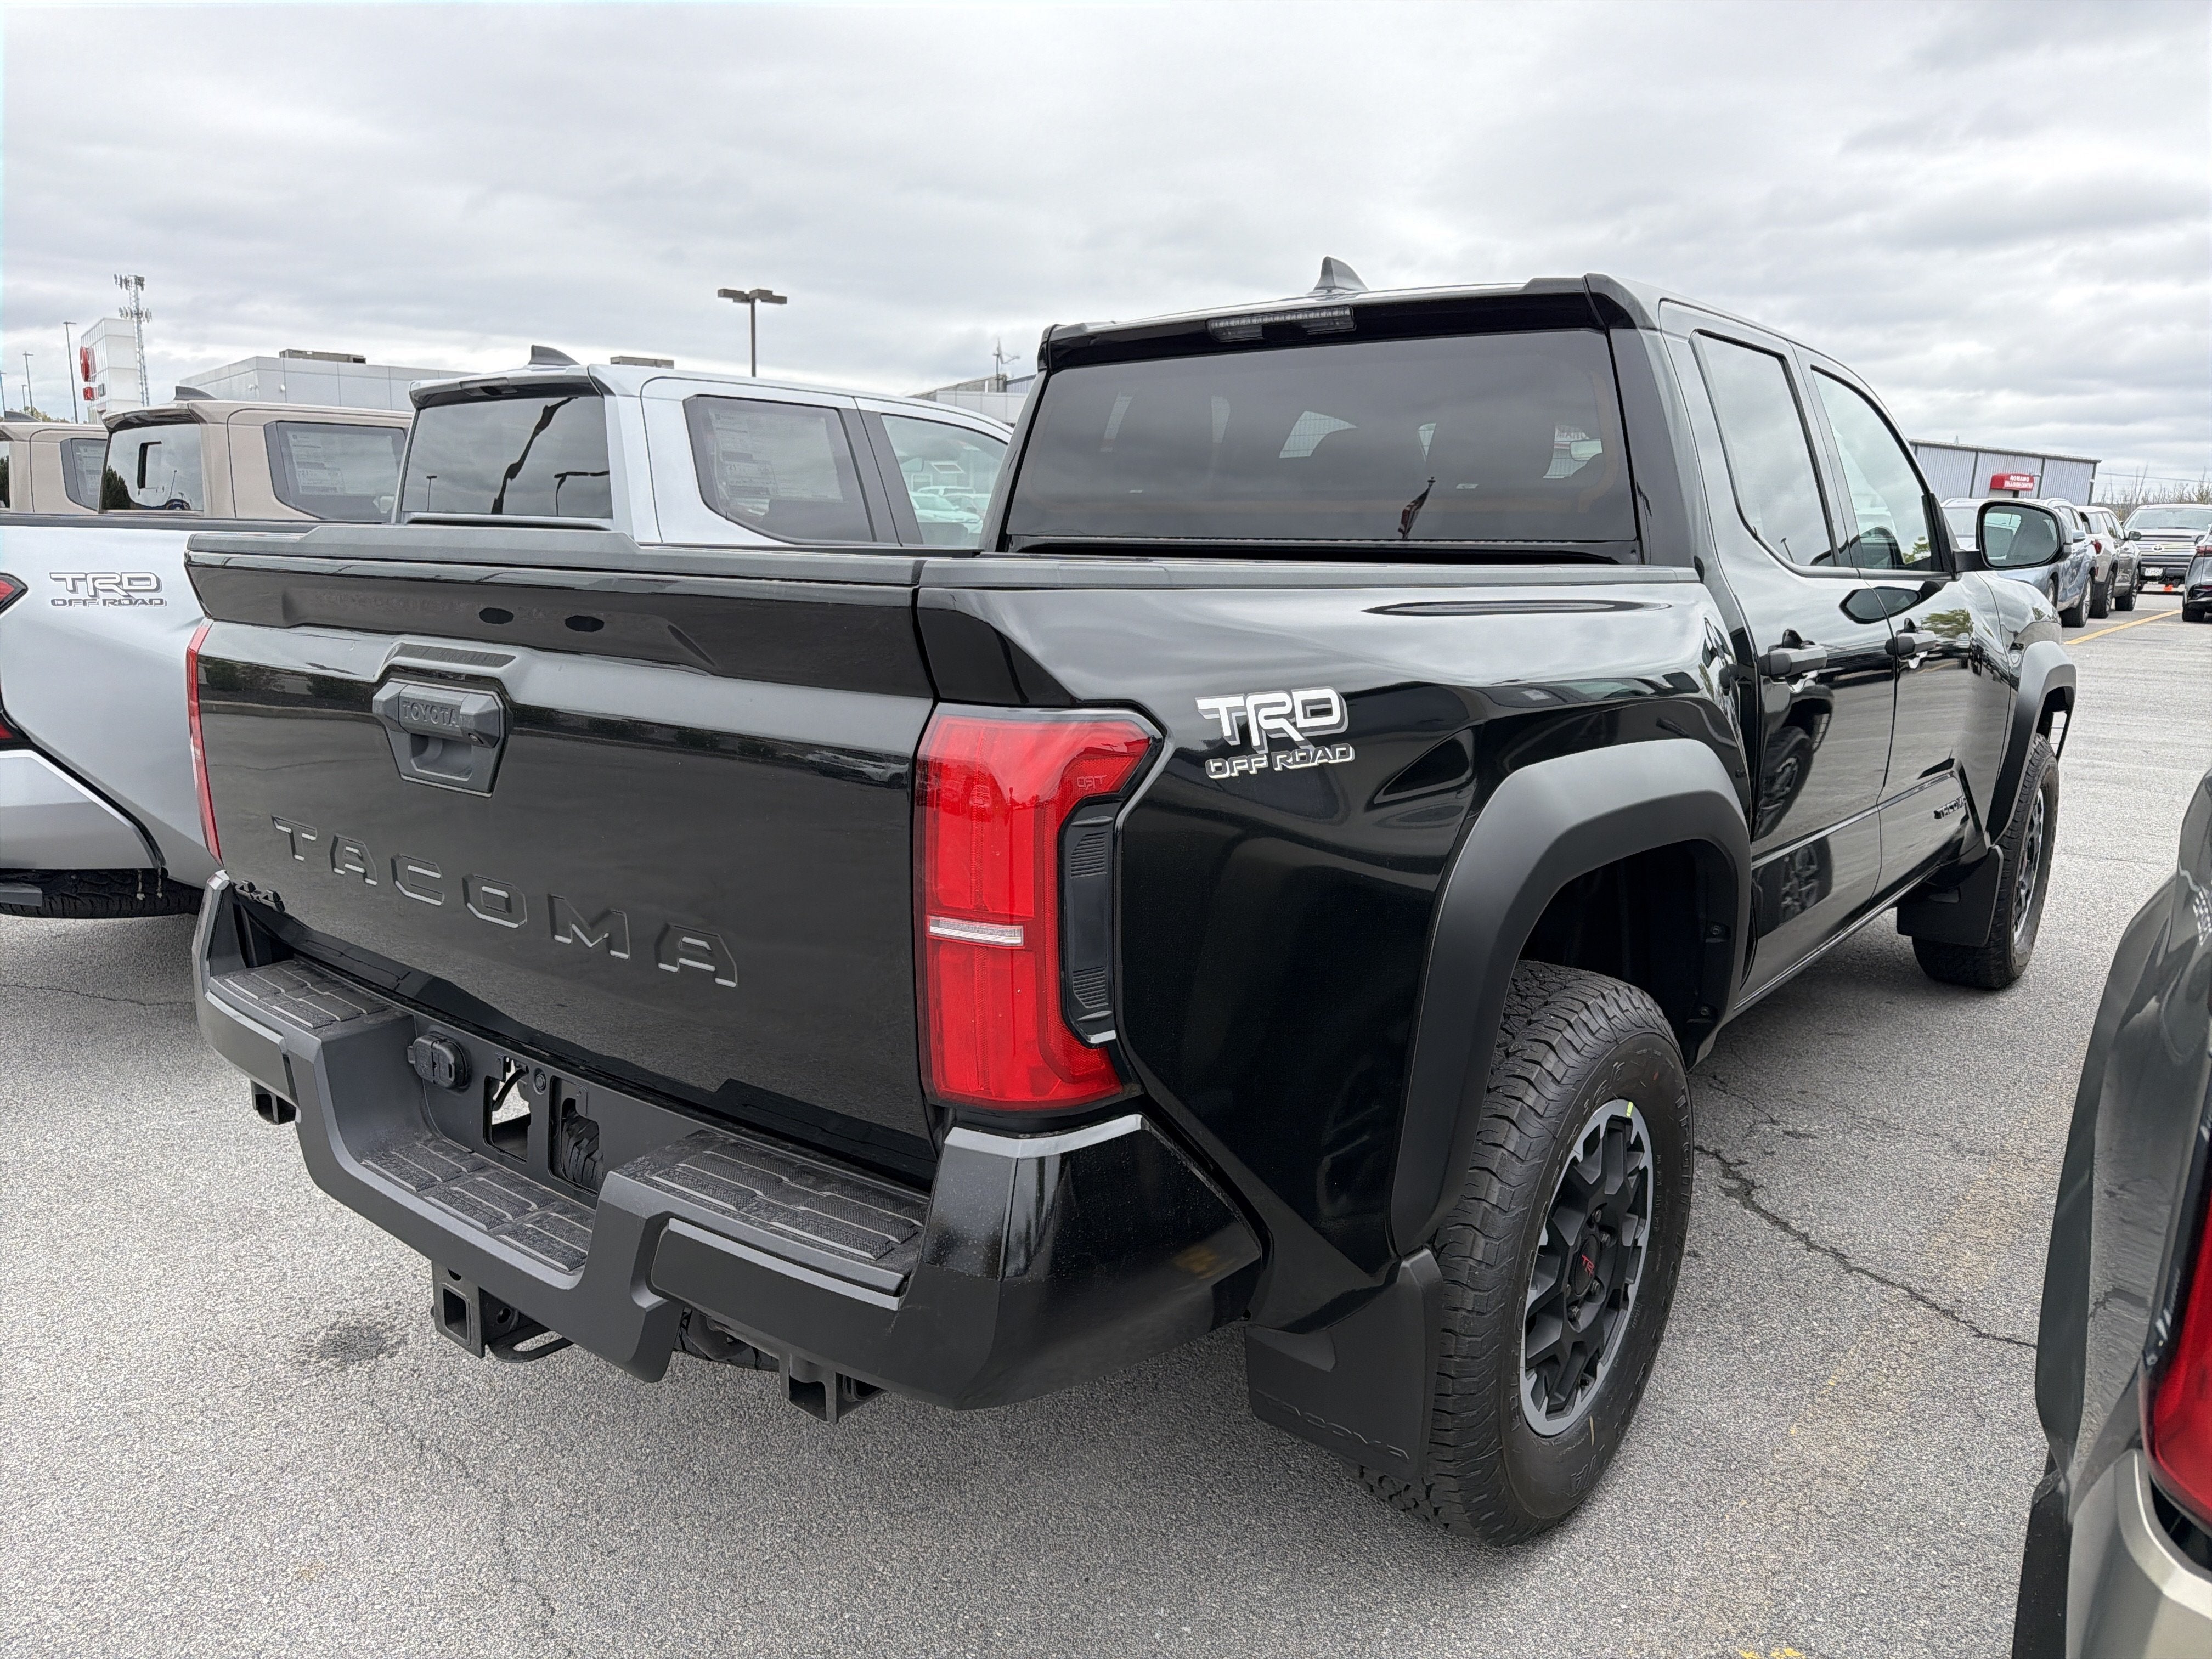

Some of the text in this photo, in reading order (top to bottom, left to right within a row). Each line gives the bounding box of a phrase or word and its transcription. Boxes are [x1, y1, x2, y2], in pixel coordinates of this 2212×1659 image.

[49, 572, 162, 599] TRD
[50, 598, 167, 607] OFF ROAD
[402, 700, 460, 728] TOYOTA
[1195, 686, 1348, 754] TRD
[1205, 743, 1355, 780] OFF ROAD
[271, 815, 737, 988] TACOMA
